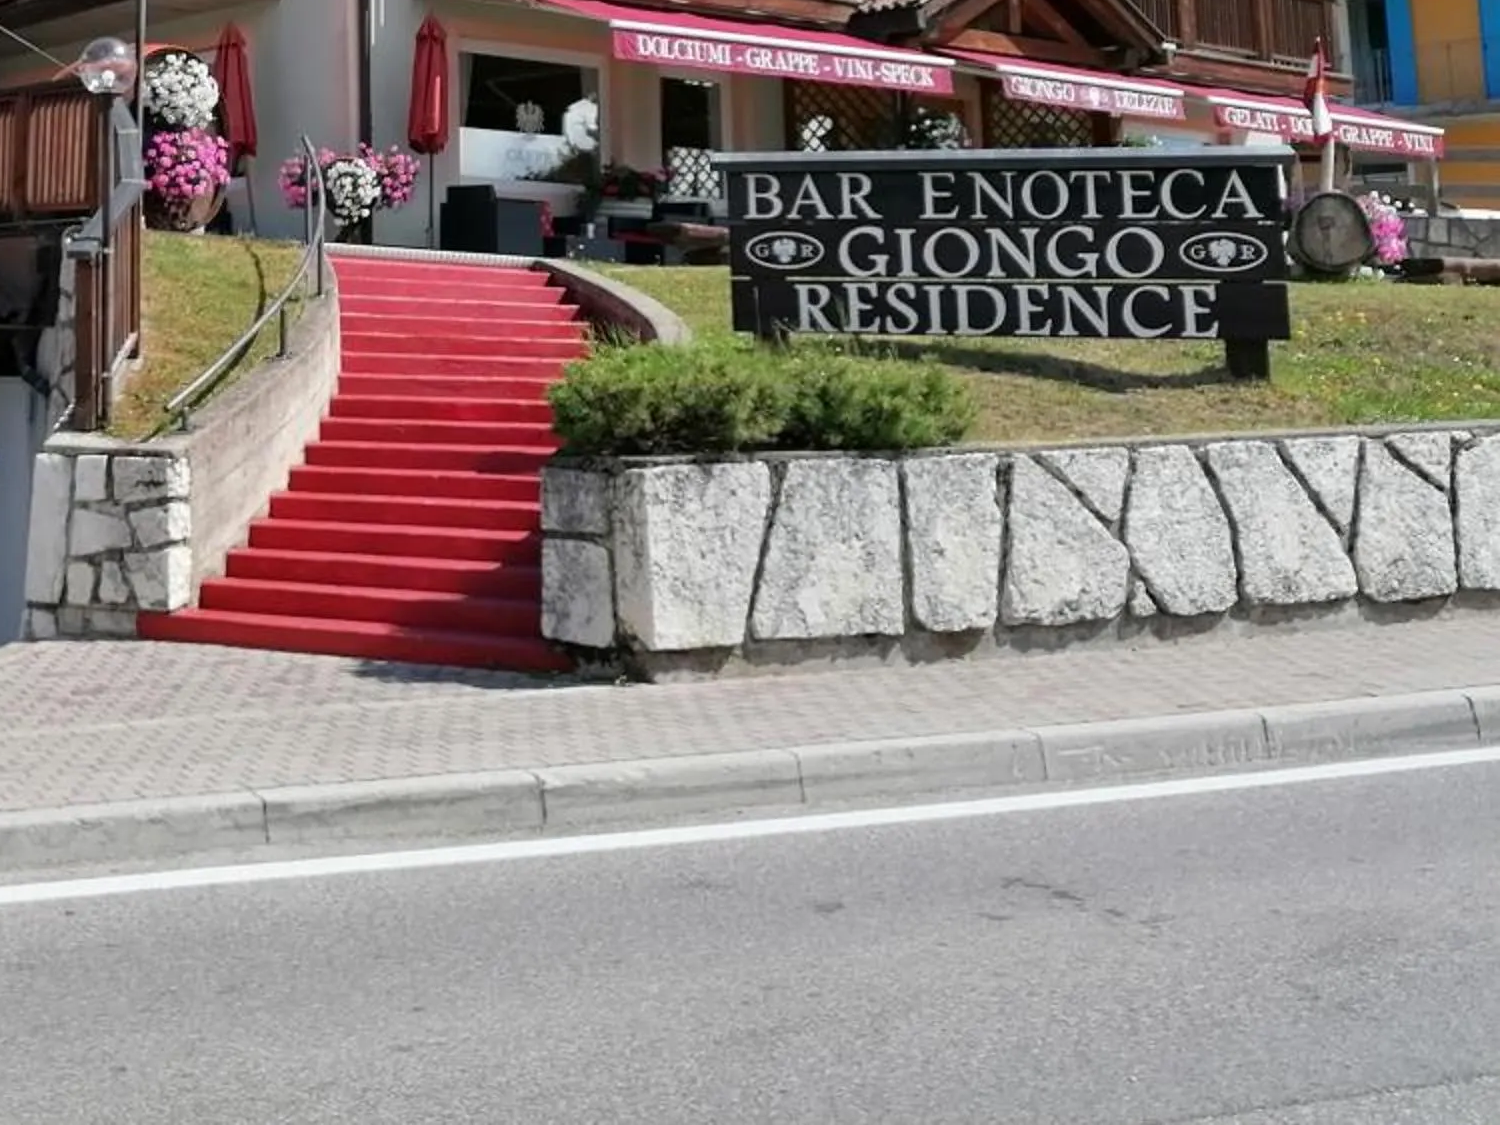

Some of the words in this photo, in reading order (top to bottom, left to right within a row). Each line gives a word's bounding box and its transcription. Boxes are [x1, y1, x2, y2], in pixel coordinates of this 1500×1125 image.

[637, 32, 732, 66] DOLCIUMI
[746, 46, 820, 76] GRAPPE
[1010, 76, 1076, 103] GIONGO
[1224, 106, 1280, 133] GELATI
[1340, 126, 1394, 149] GRAPPE
[1403, 134, 1435, 153] VINI
[742, 172, 884, 220] BAR
[918, 168, 1265, 221] ENOTECA
[754, 243, 770, 259] G
[800, 243, 817, 259] R
[837, 225, 1165, 279] GIONGO
[1190, 243, 1207, 260] G
[1239, 244, 1257, 260] R
[793, 281, 1220, 339] RESIDENCE
